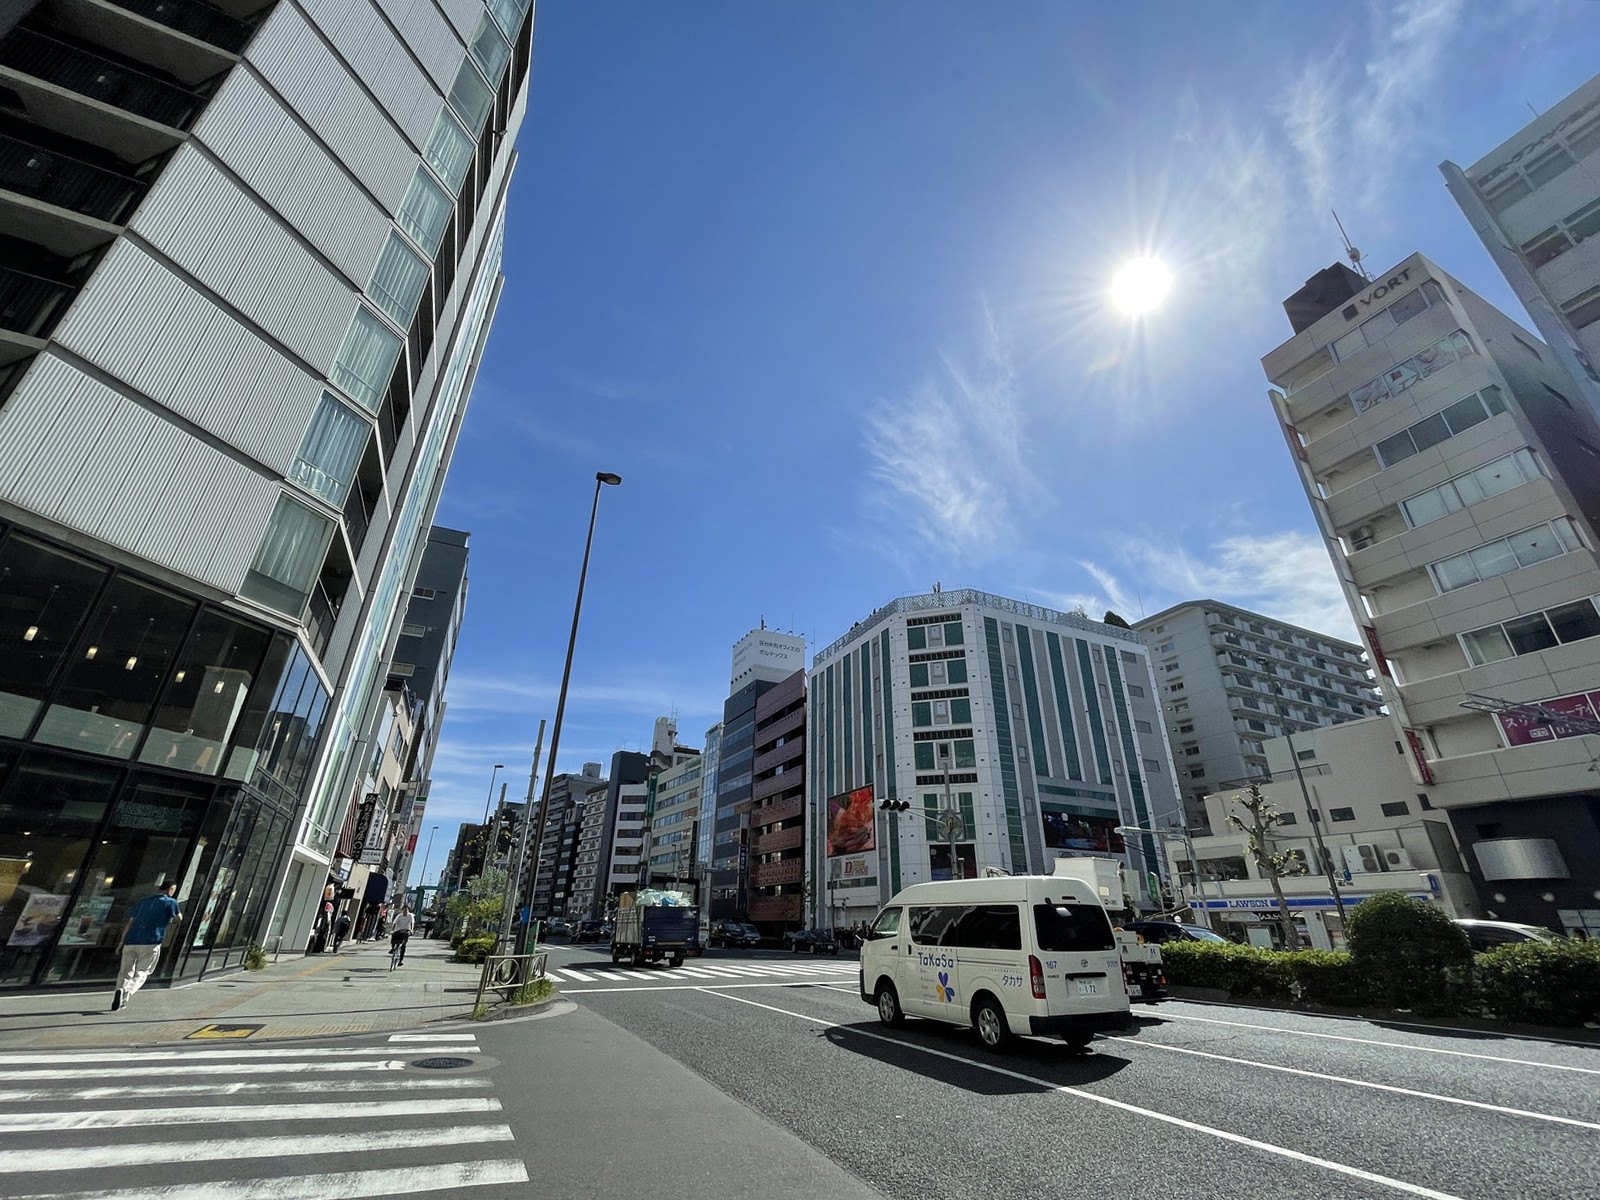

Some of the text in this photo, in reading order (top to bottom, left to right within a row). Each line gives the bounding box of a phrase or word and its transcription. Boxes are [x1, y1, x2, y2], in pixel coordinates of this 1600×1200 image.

[1360, 267, 1411, 306] VORT
[1229, 900, 1269, 908] LAWSON
[918, 952, 954, 968] TaKaSa
[1002, 975, 1023, 987] タカサ
